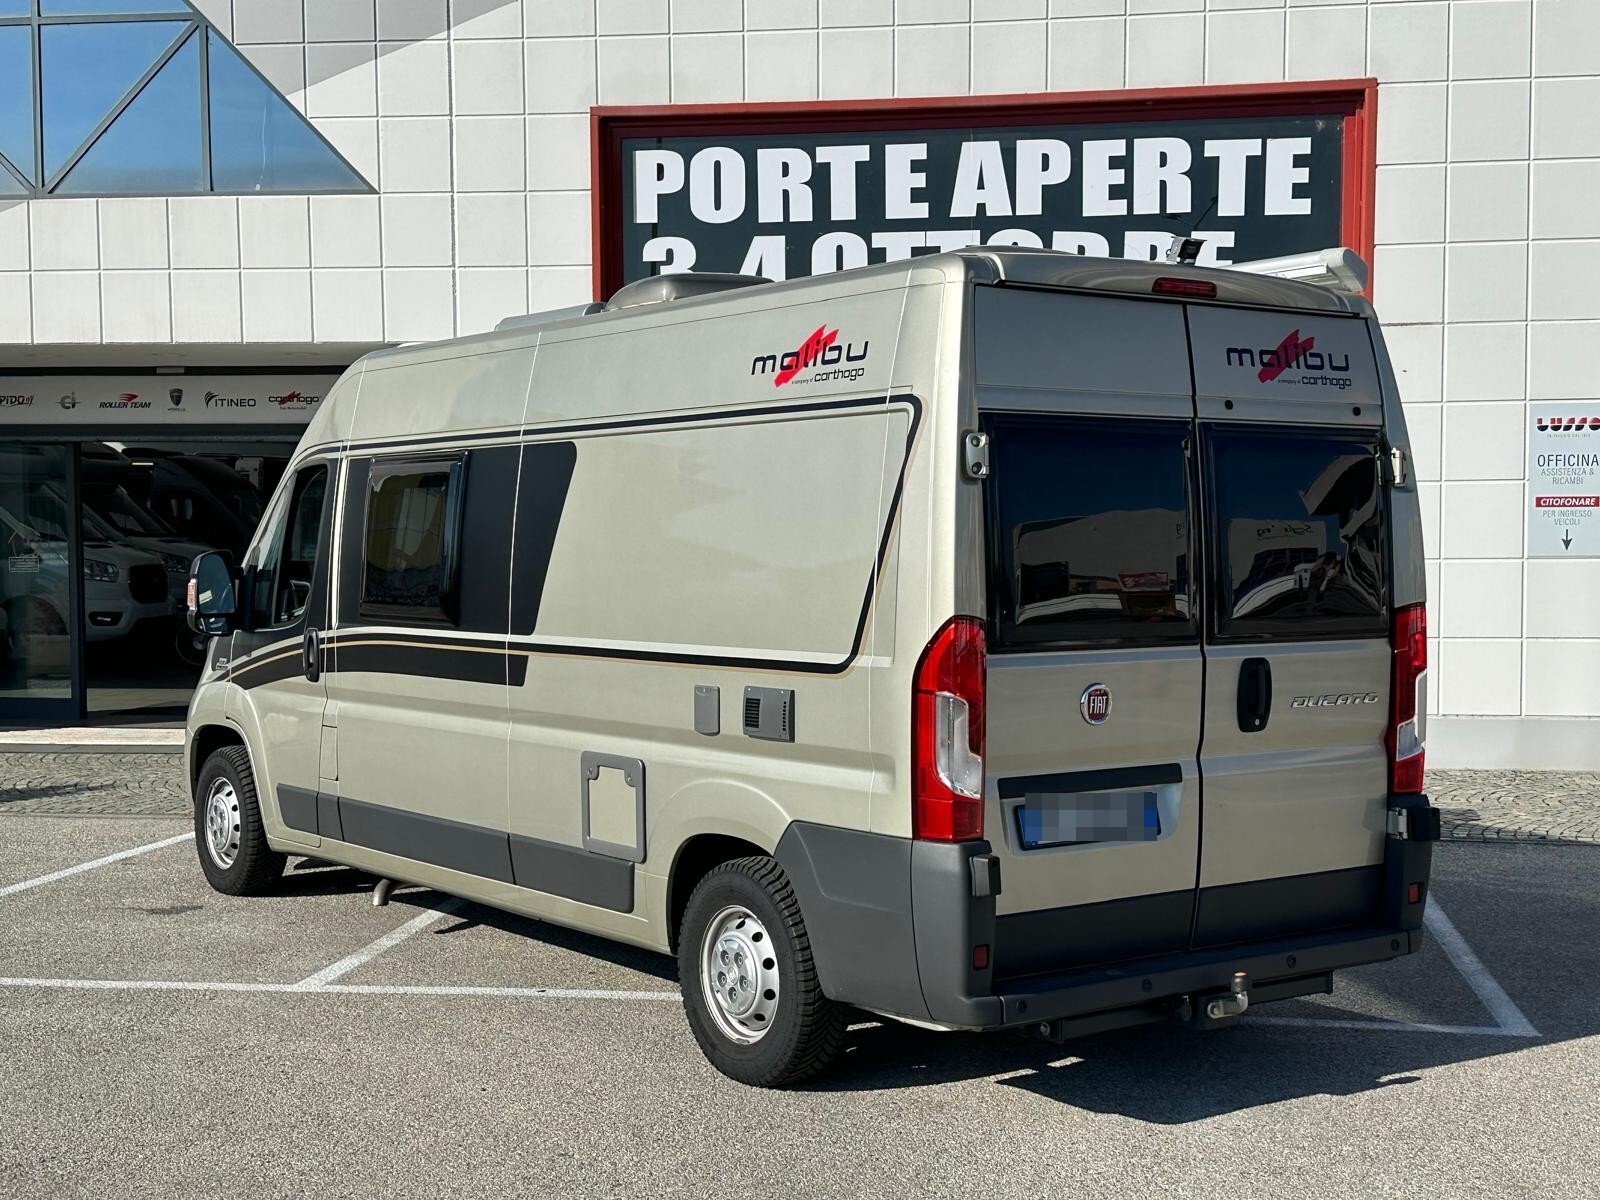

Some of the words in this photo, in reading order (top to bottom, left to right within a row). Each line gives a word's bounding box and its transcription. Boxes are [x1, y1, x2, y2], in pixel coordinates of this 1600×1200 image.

[633, 143, 931, 225] PORTE
[949, 136, 1313, 218] APERTE
[751, 340, 869, 376] malibu
[1226, 342, 1350, 372] malibu
[814, 367, 865, 382] carthago
[1301, 375, 1352, 390] carthago
[99, 401, 128, 409] ROLLER
[130, 401, 151, 409] TEAM
[215, 398, 257, 408] ITINEO
[1537, 417, 1600, 431] LUSSO
[1537, 454, 1599, 467] OFFICINA
[1541, 467, 1587, 476] ASSISTENZA
[1552, 476, 1584, 485] RICAMBI
[1540, 498, 1596, 506] CITOFONARE
[1542, 509, 1556, 517] PER
[1557, 509, 1592, 518] INGRESSO
[1554, 518, 1580, 526] VEICOLI
[1089, 695, 1108, 714] FIAT
[1291, 691, 1379, 708] DUCATO
